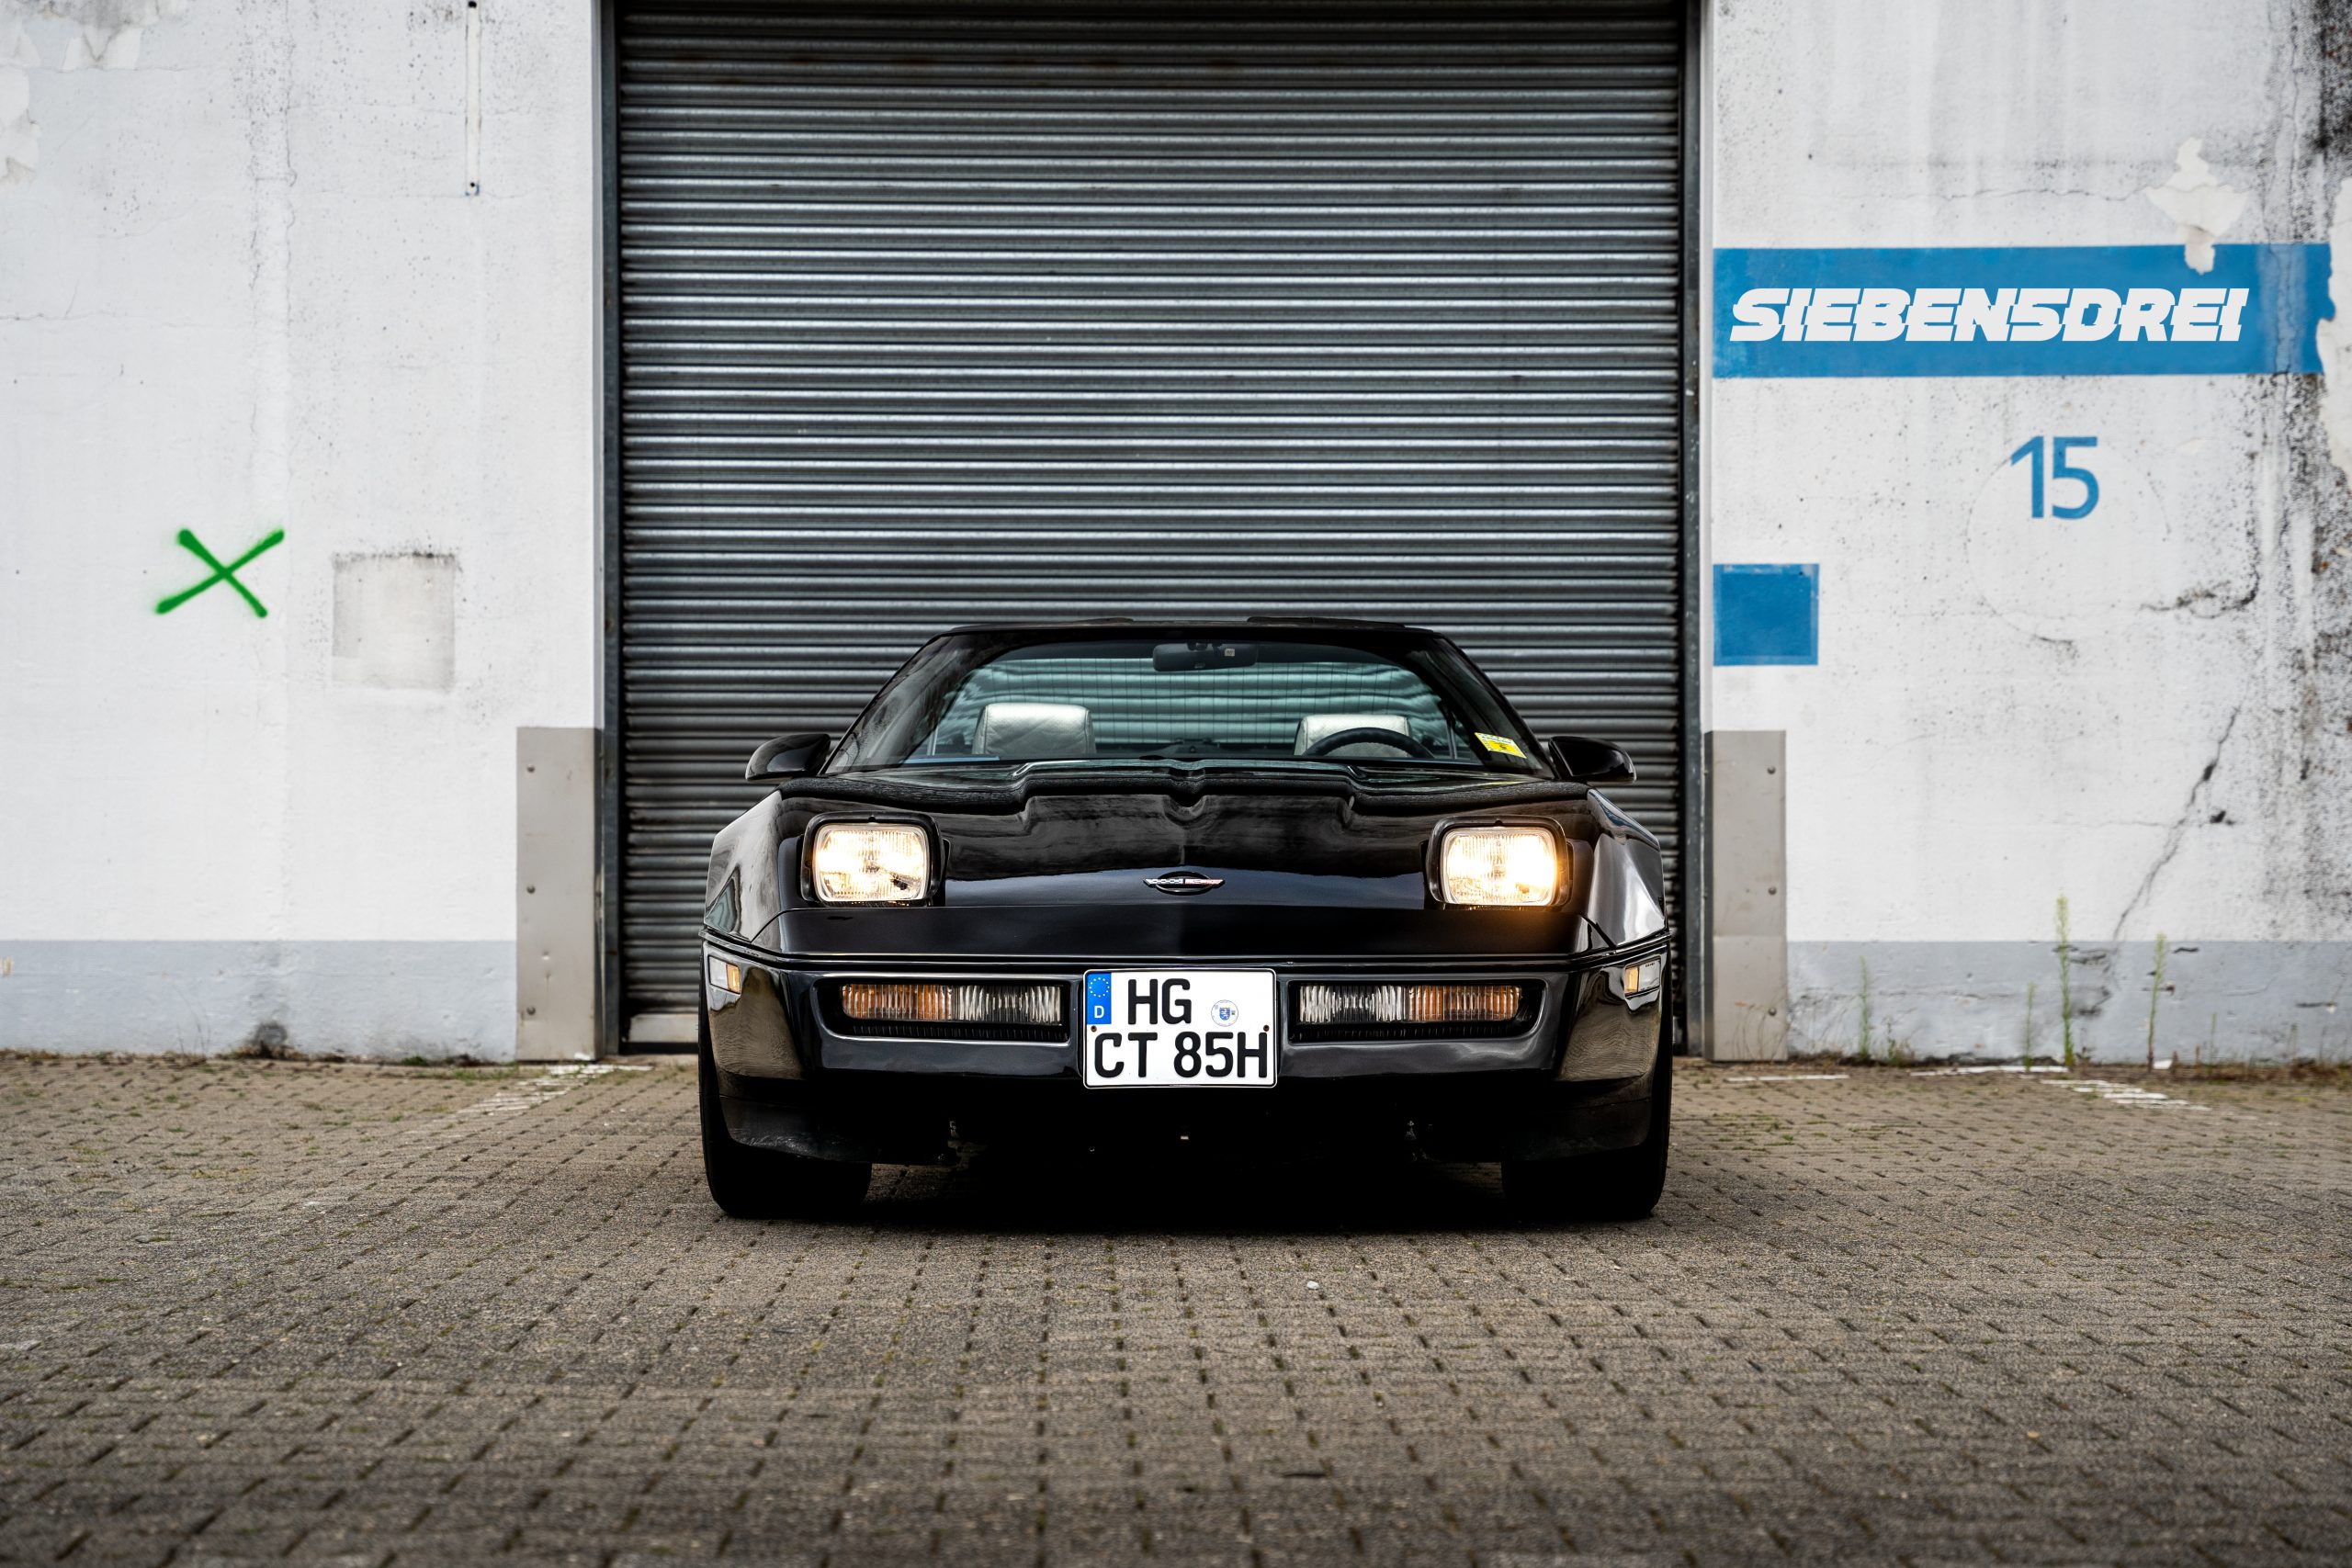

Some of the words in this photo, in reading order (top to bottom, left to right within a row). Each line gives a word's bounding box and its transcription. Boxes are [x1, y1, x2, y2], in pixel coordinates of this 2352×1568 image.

[2009, 435, 2100, 520] 15
[1093, 1005, 1105, 1019] D
[1127, 977, 1193, 1025] HG
[1094, 1032, 1159, 1078] CT
[1173, 1032, 1268, 1078] 85H
